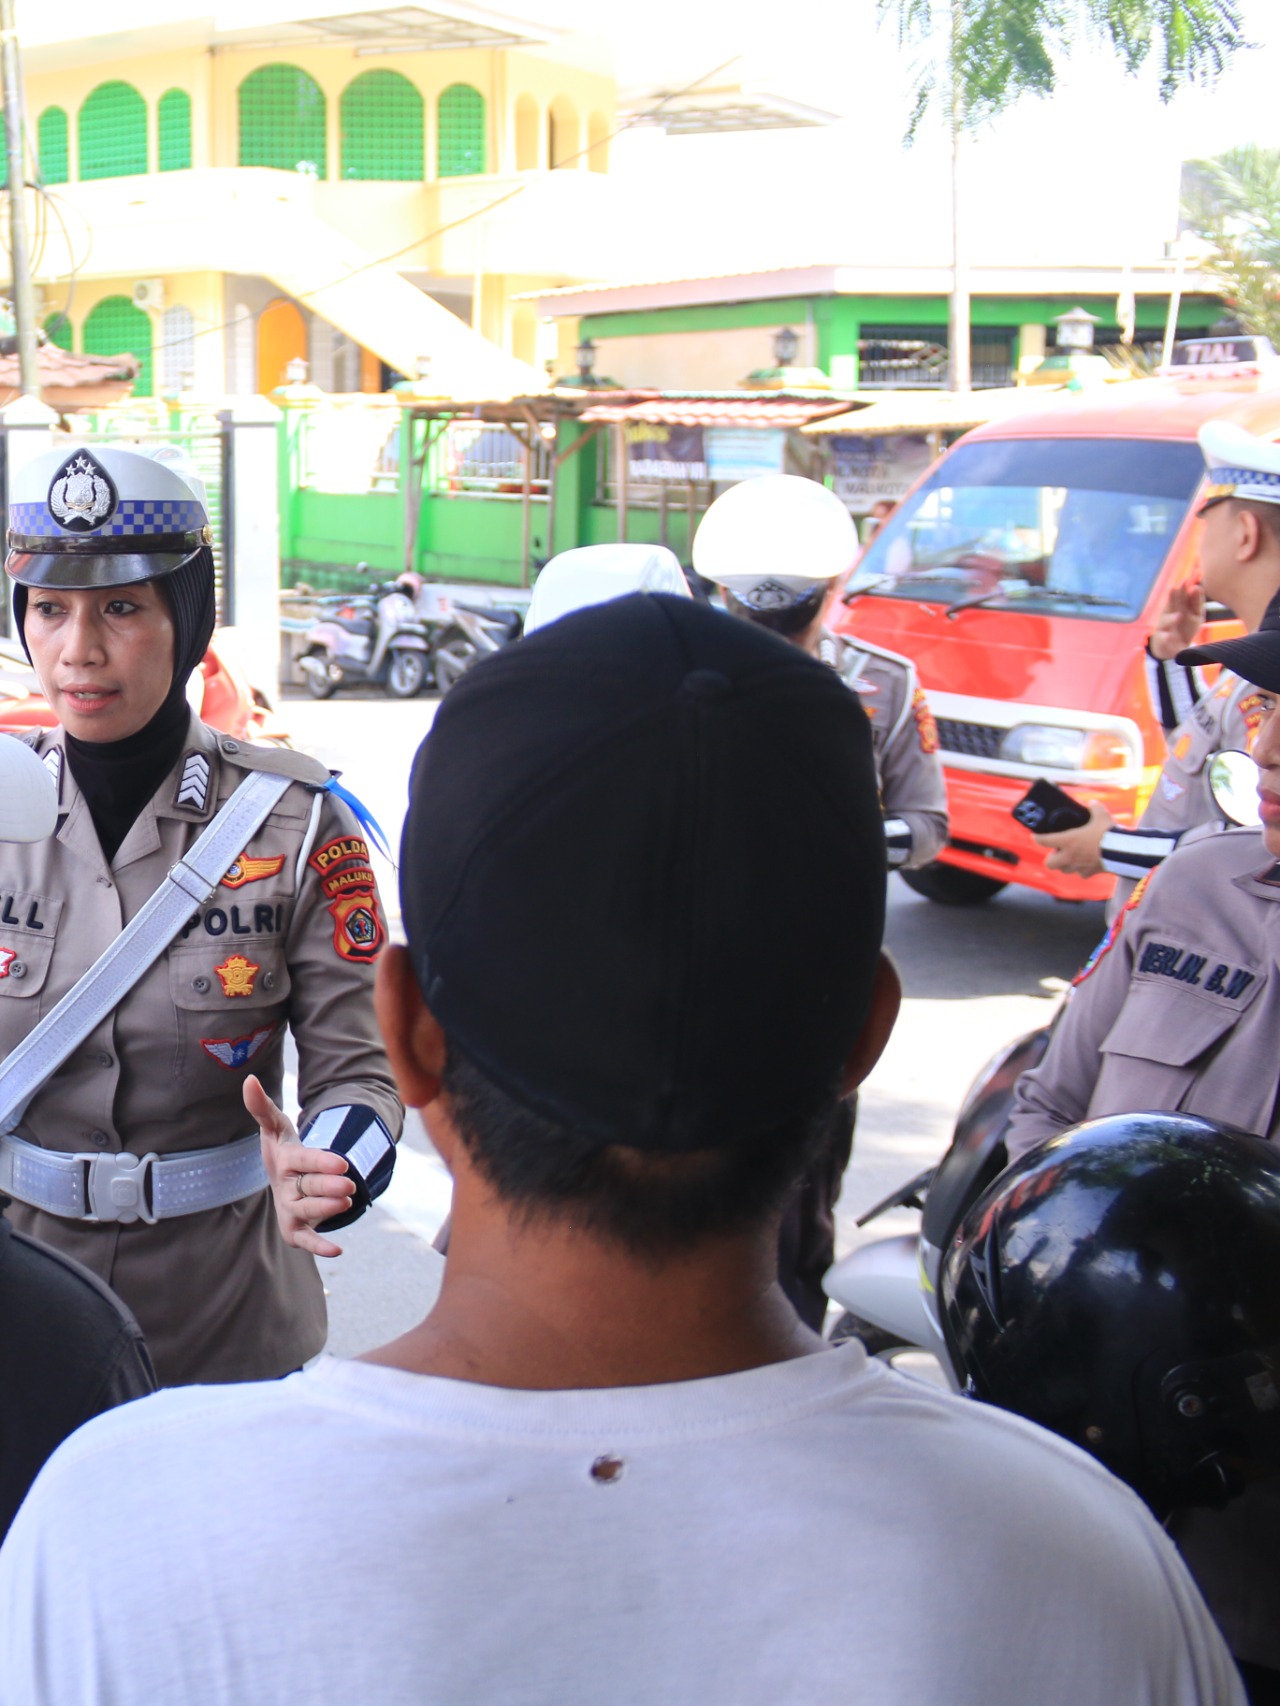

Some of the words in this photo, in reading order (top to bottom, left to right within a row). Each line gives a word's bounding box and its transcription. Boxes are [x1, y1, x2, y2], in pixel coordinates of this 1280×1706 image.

[317, 840, 368, 868] POLDA
[328, 871, 373, 892] MALUKU
[181, 903, 282, 939] POLRI
